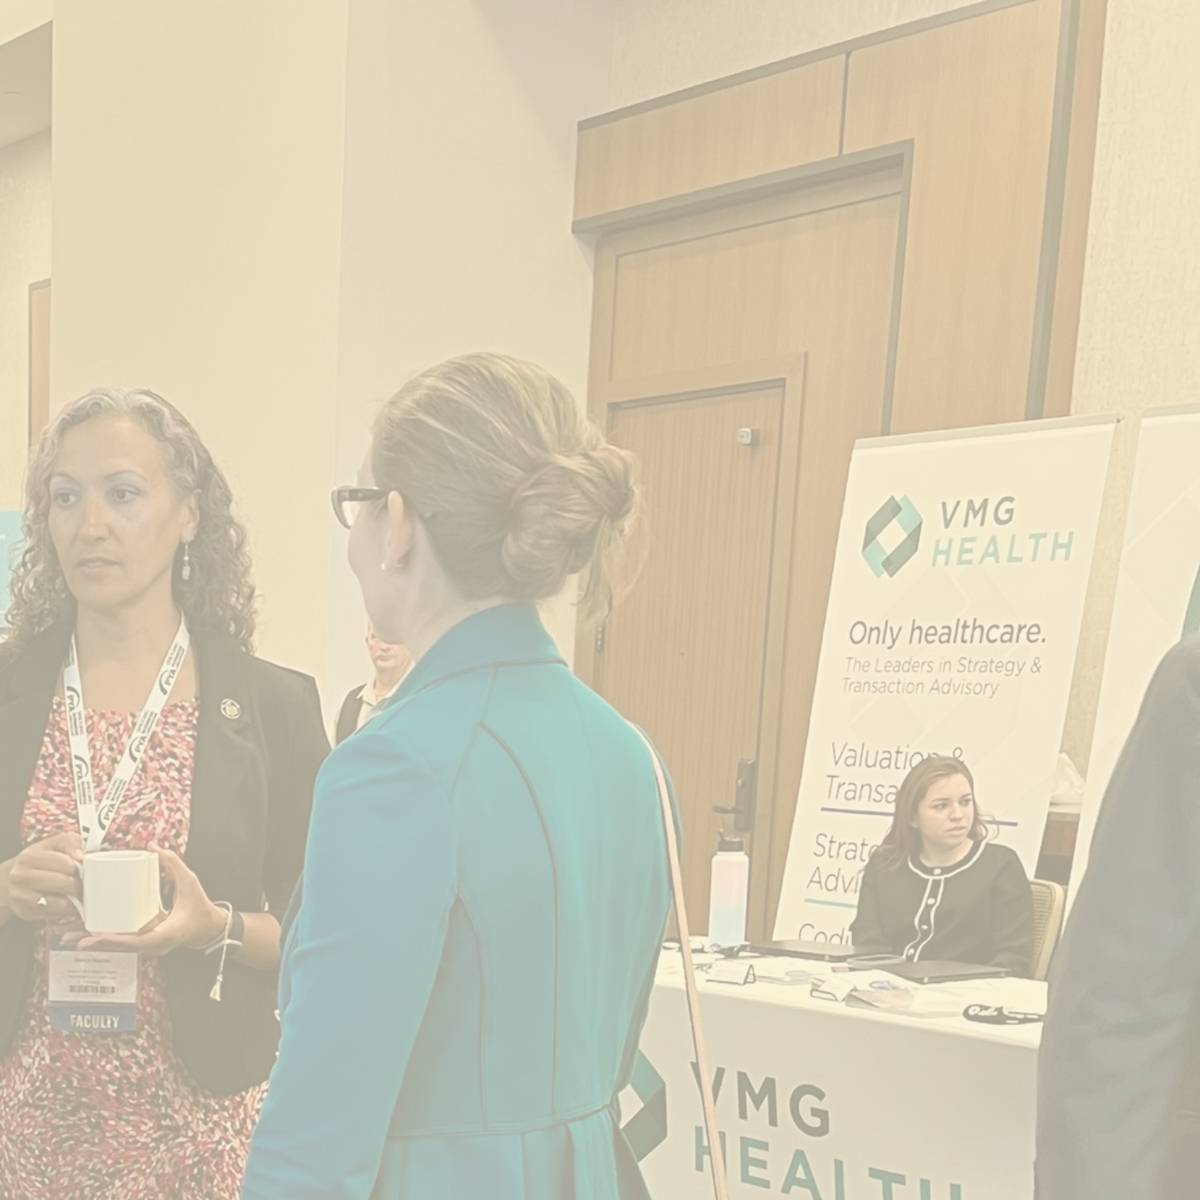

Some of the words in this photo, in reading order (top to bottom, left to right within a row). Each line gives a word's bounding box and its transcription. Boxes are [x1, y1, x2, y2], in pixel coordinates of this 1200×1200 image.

[941, 496, 1016, 529] VMG
[931, 531, 1075, 567] HEALTH
[849, 619, 903, 650] Only
[908, 617, 1047, 645] healthcare.
[844, 656, 871, 673] The
[874, 656, 934, 673] Leaders
[938, 656, 952, 673] in
[956, 656, 1026, 677] Strategy
[1029, 656, 1042, 674] &
[842, 676, 925, 695] Transaction
[928, 677, 1001, 699] Advisory
[831, 740, 940, 770] Valuatio
[825, 774, 897, 804] Transa
[813, 832, 879, 863] Strat
[806, 866, 860, 894] Advi
[69, 1014, 121, 1029] FACULTY
[690, 1060, 831, 1138] VMG
